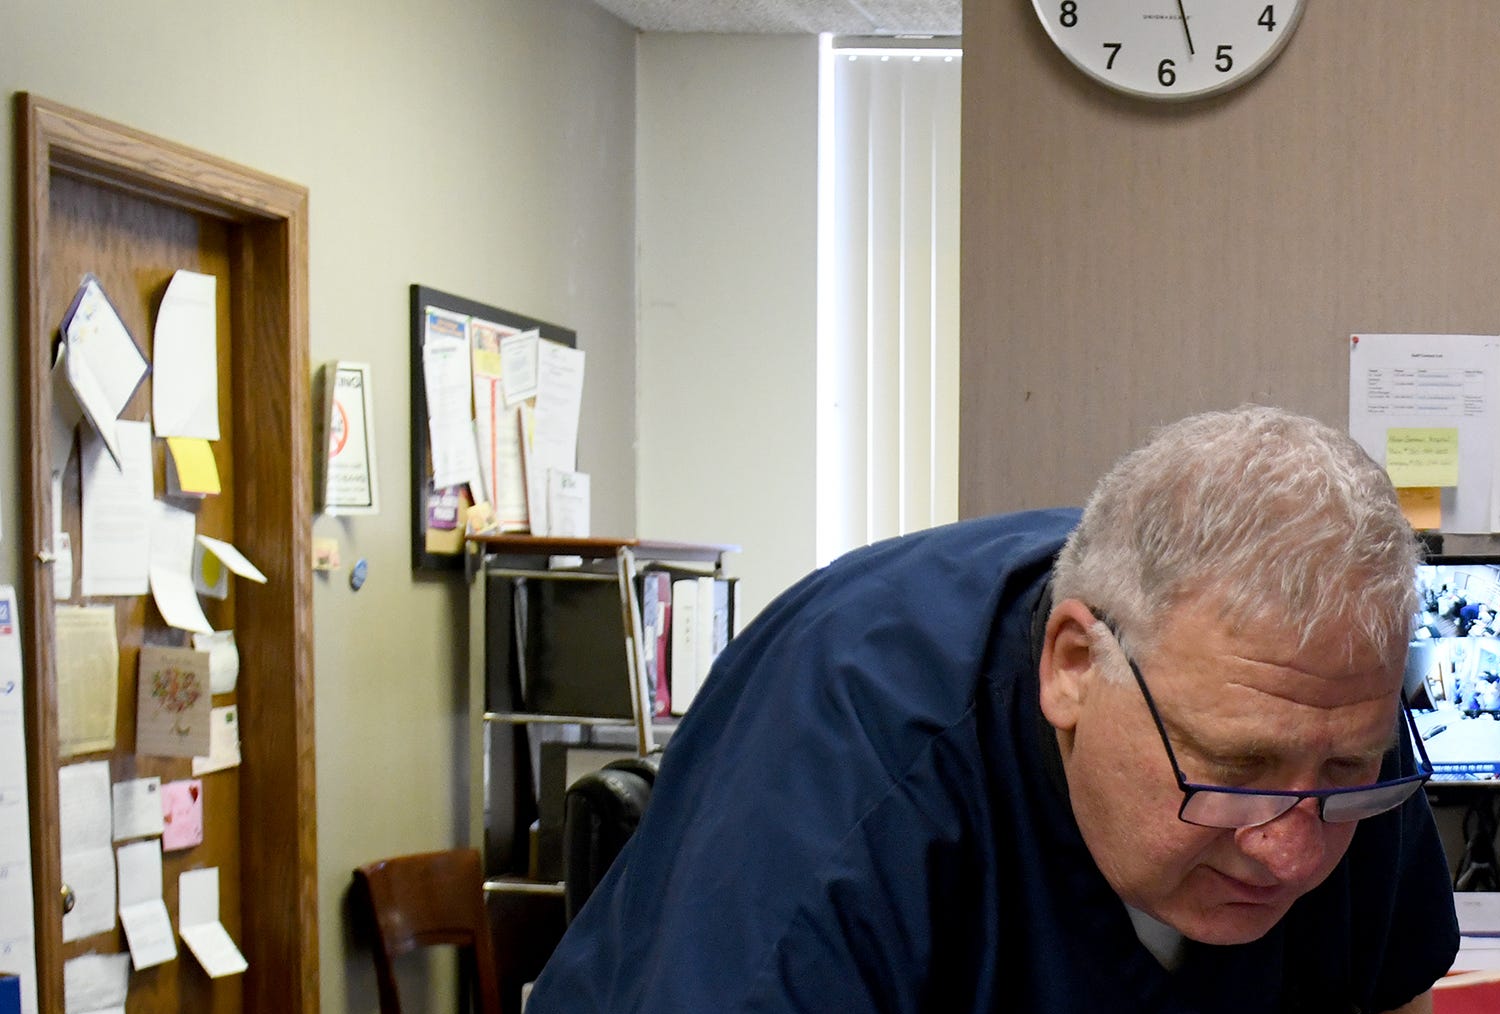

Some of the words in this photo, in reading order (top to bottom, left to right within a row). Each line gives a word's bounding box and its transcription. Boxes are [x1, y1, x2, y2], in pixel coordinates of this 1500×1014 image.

[1059, 0, 1079, 28] 8
[1257, 5, 1276, 32] 4
[1102, 42, 1122, 70] 7
[1214, 45, 1234, 73] 5
[1157, 58, 1176, 87] 6
